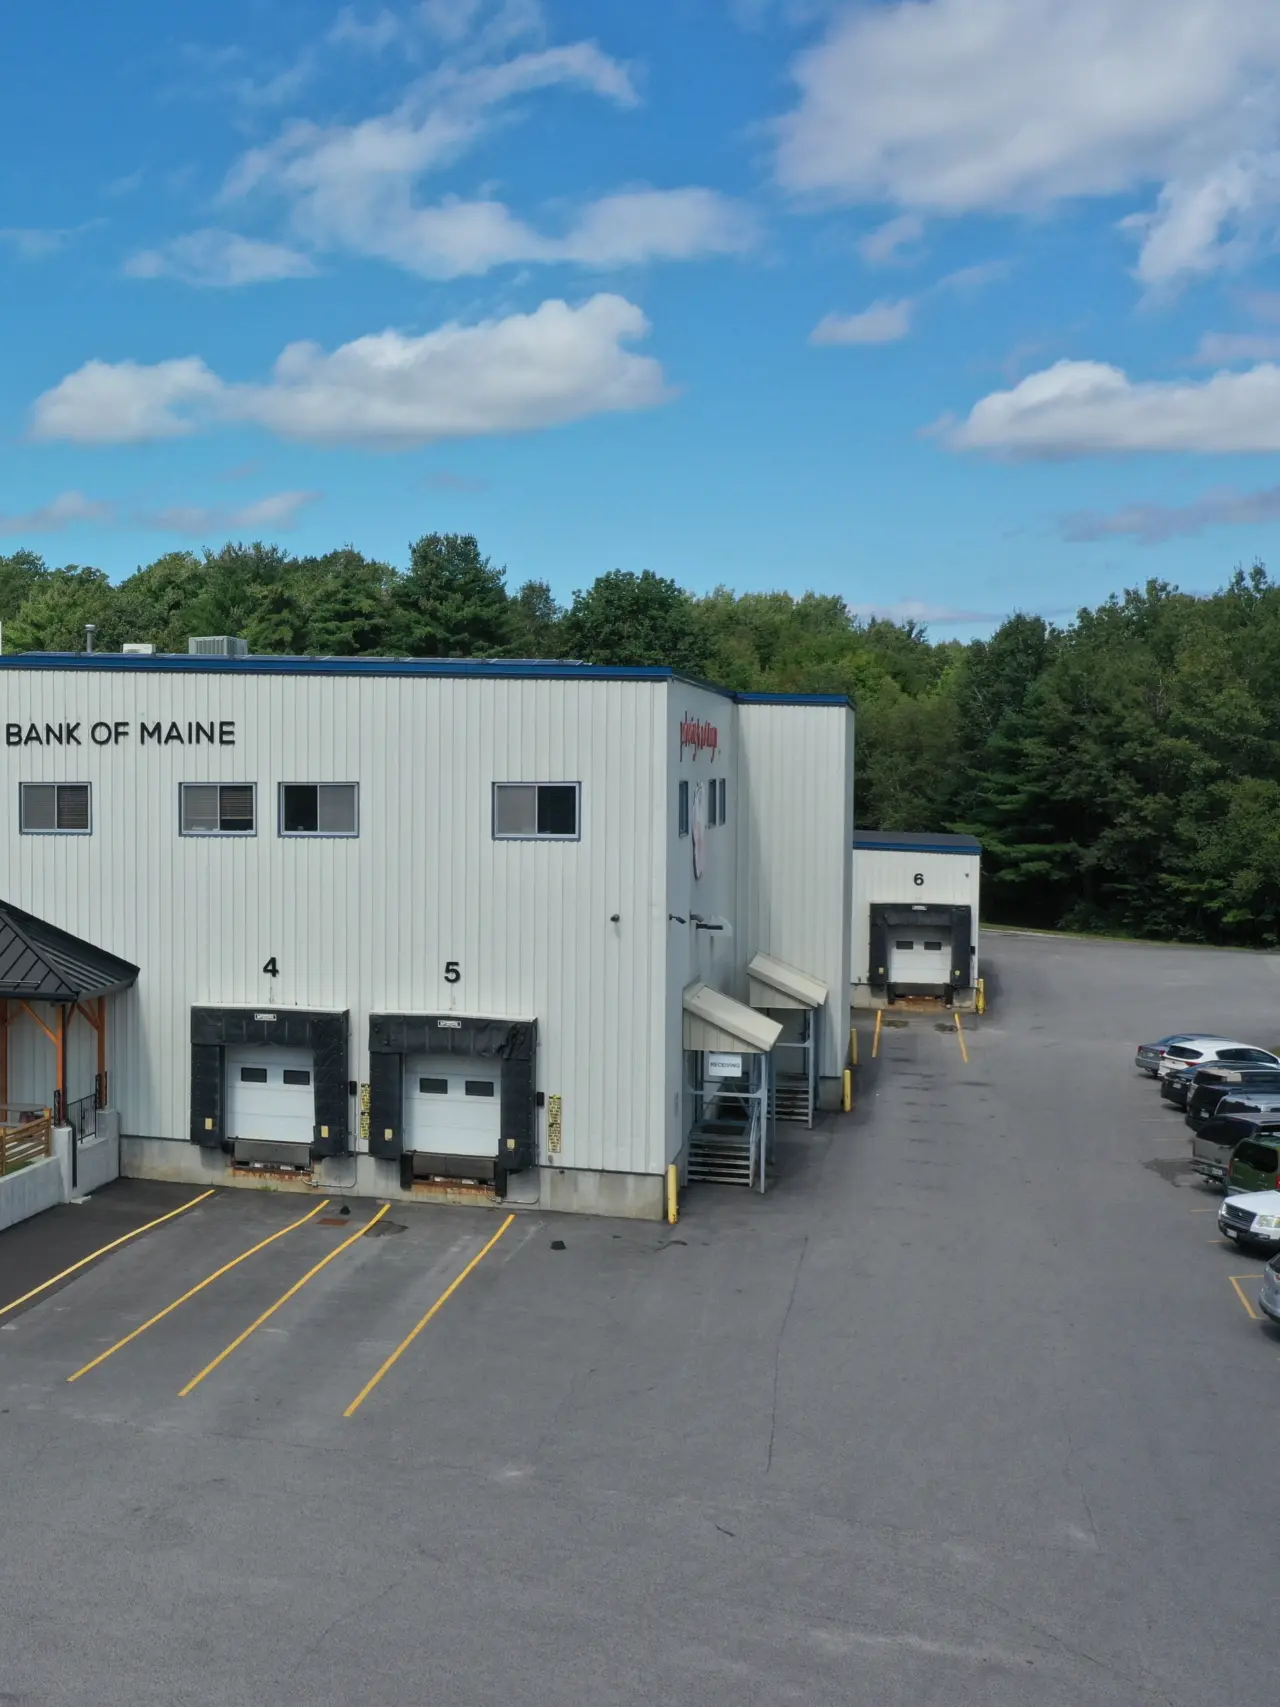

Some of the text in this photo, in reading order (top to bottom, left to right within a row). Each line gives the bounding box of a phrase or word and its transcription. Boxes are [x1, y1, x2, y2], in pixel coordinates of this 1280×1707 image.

[5, 721, 82, 747] BANK
[90, 721, 130, 747] OF
[140, 720, 236, 747] MAINE
[913, 872, 925, 887] 6
[262, 956, 280, 978] 4
[443, 961, 461, 984] 5
[710, 1061, 740, 1069] RECEIVING
